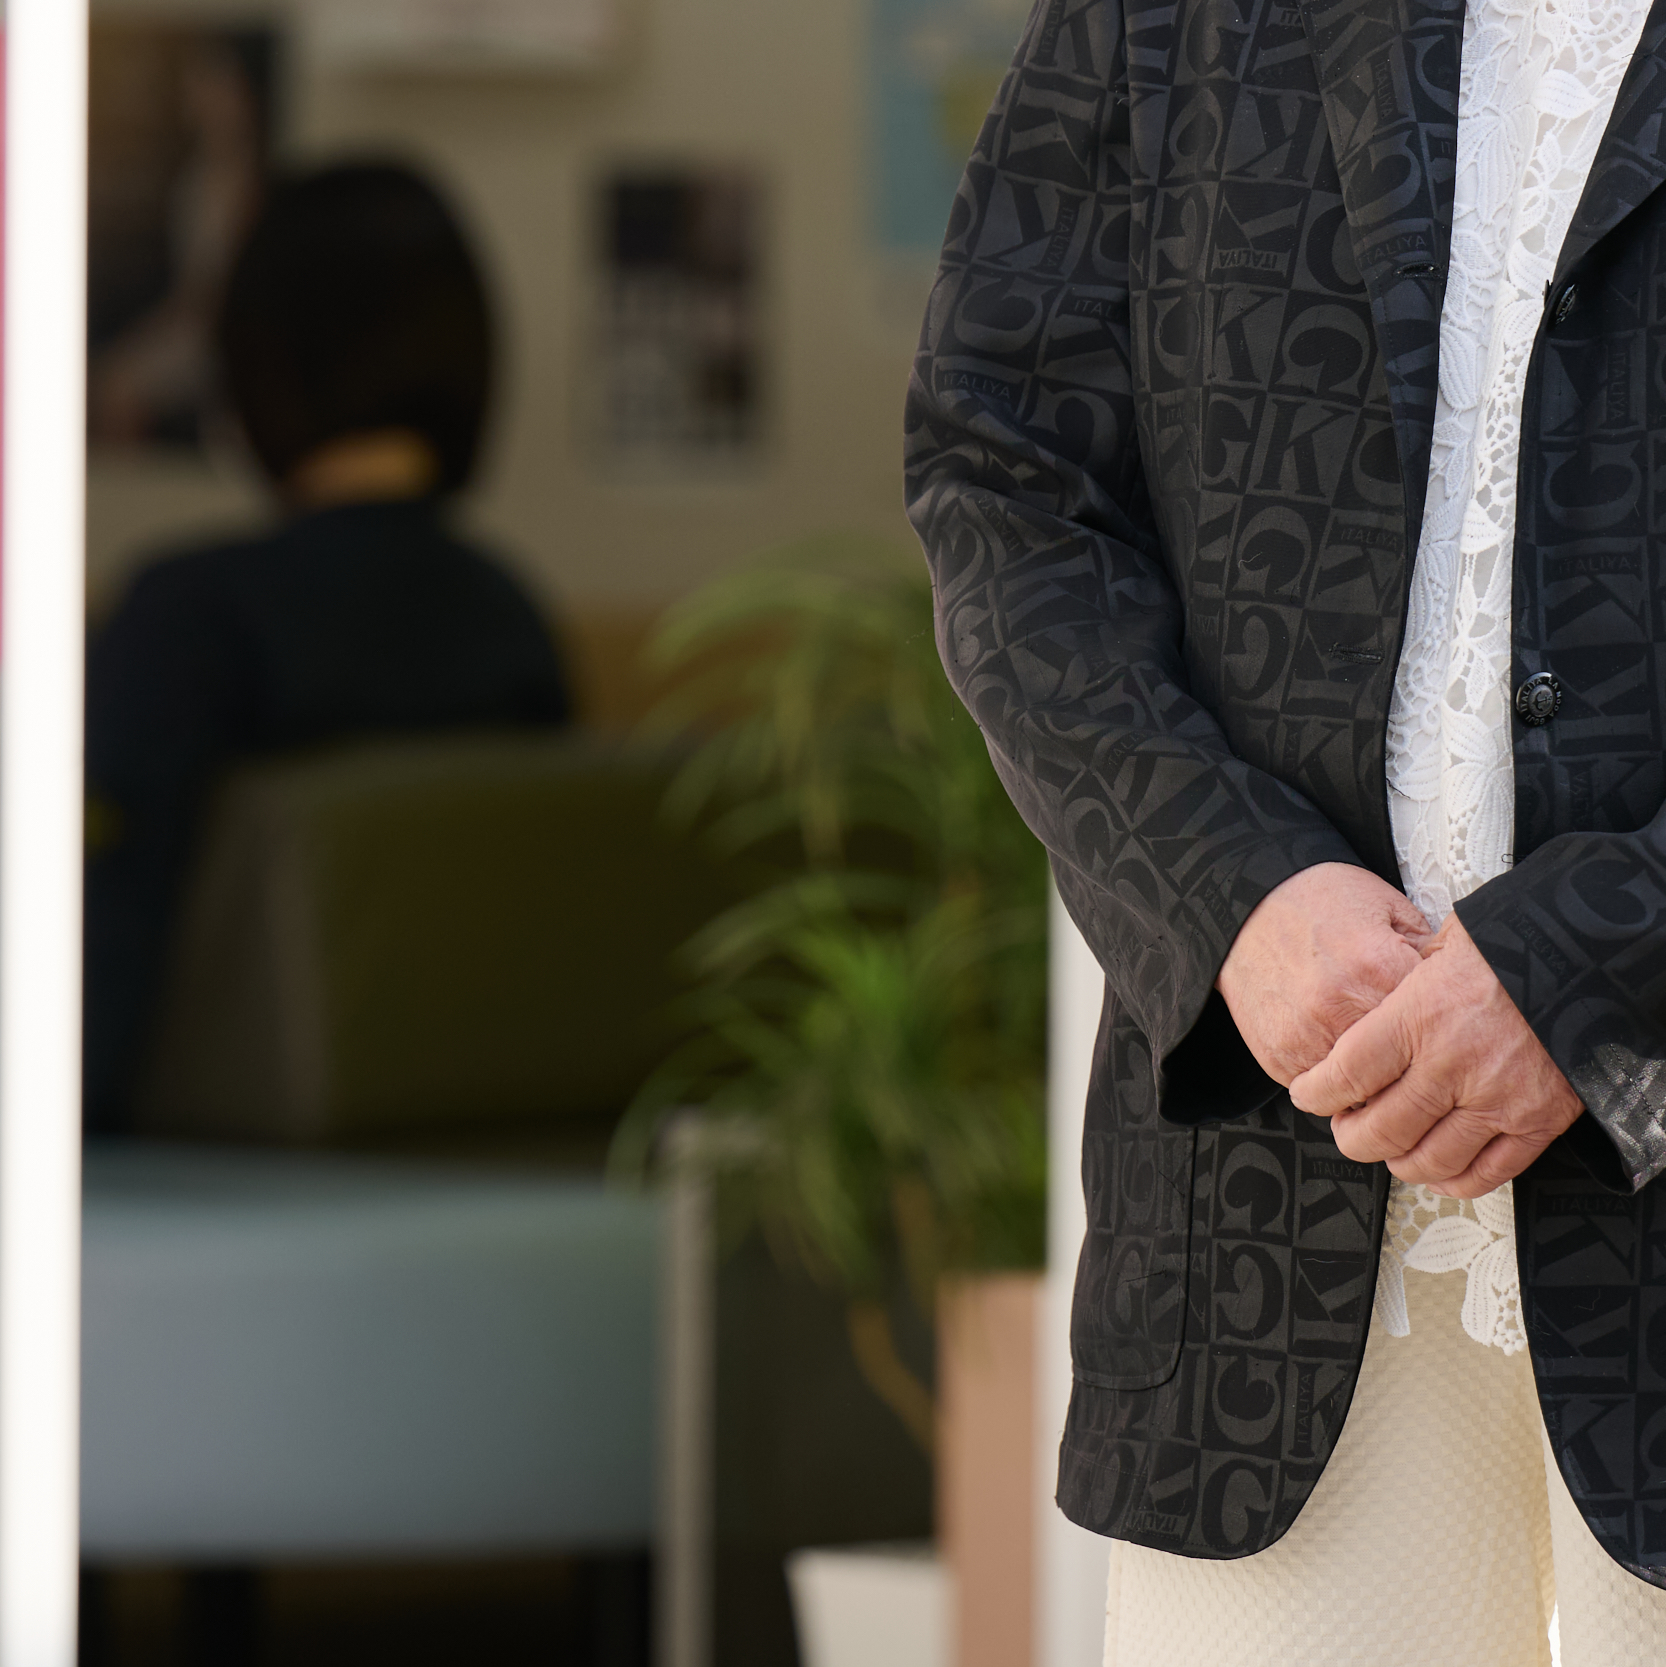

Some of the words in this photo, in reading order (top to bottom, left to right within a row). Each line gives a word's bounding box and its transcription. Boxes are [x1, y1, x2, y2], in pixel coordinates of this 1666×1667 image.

[1044, 207, 1075, 268] ITALIYA
[1359, 234, 1428, 269] ITALIYA
[943, 372, 1011, 400] ITALIYA
[1609, 351, 1627, 421] ITALIYA
[1558, 555, 1632, 574] ITALIYA
[1312, 1160, 1365, 1180] ITALIYA
[1552, 1196, 1627, 1215] ITALIYA
[1295, 1372, 1313, 1444] ITALIYA
